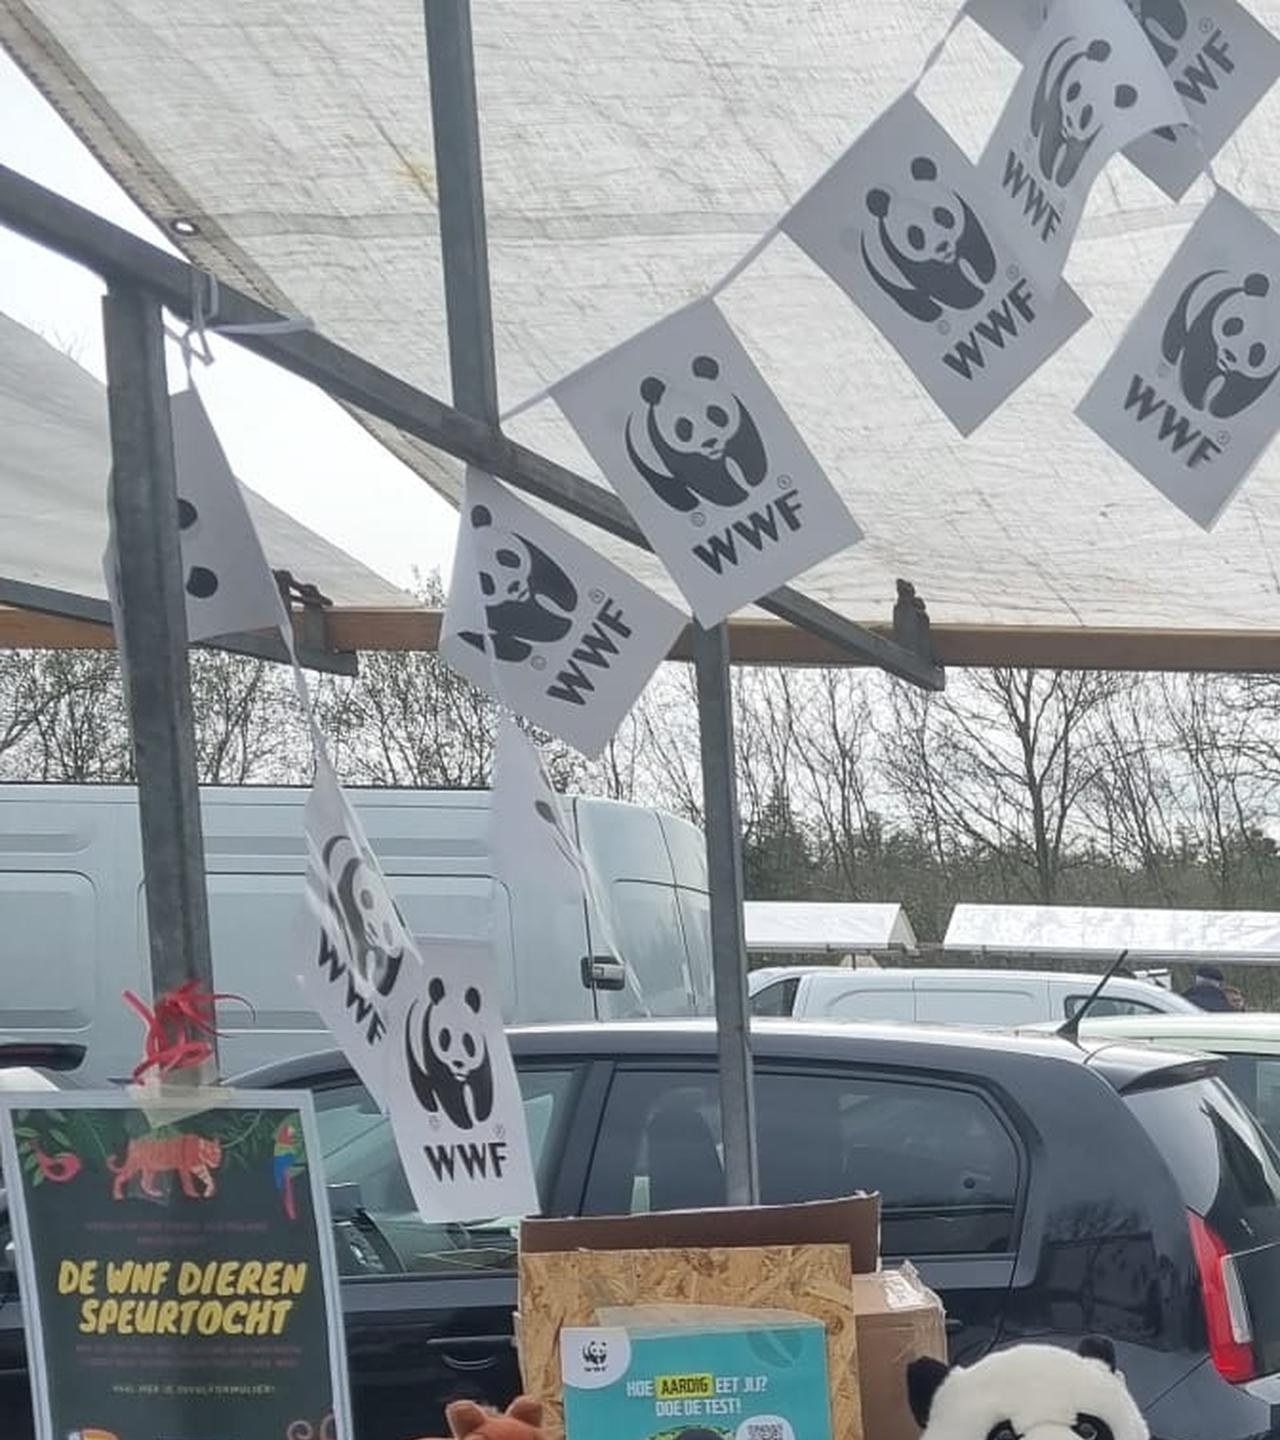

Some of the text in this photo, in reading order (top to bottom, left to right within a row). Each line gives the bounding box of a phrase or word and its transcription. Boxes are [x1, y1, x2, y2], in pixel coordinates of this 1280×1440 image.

[1002, 150, 1062, 243] WWF
[941, 276, 1037, 382] WWF
[1123, 373, 1221, 471] WWF
[691, 491, 804, 577] WWF
[546, 597, 632, 706] WWF
[317, 925, 388, 1048] WWF
[424, 1142, 508, 1182] WWF
[58, 1259, 307, 1296] DE WNF DIEREN
[78, 1299, 294, 1335] SPEURTOCHT
[627, 1382, 653, 1397] HOE
[661, 1377, 708, 1395] AARDIG
[715, 1377, 738, 1393] EET
[656, 1398, 741, 1416] DOE DE TEST!
